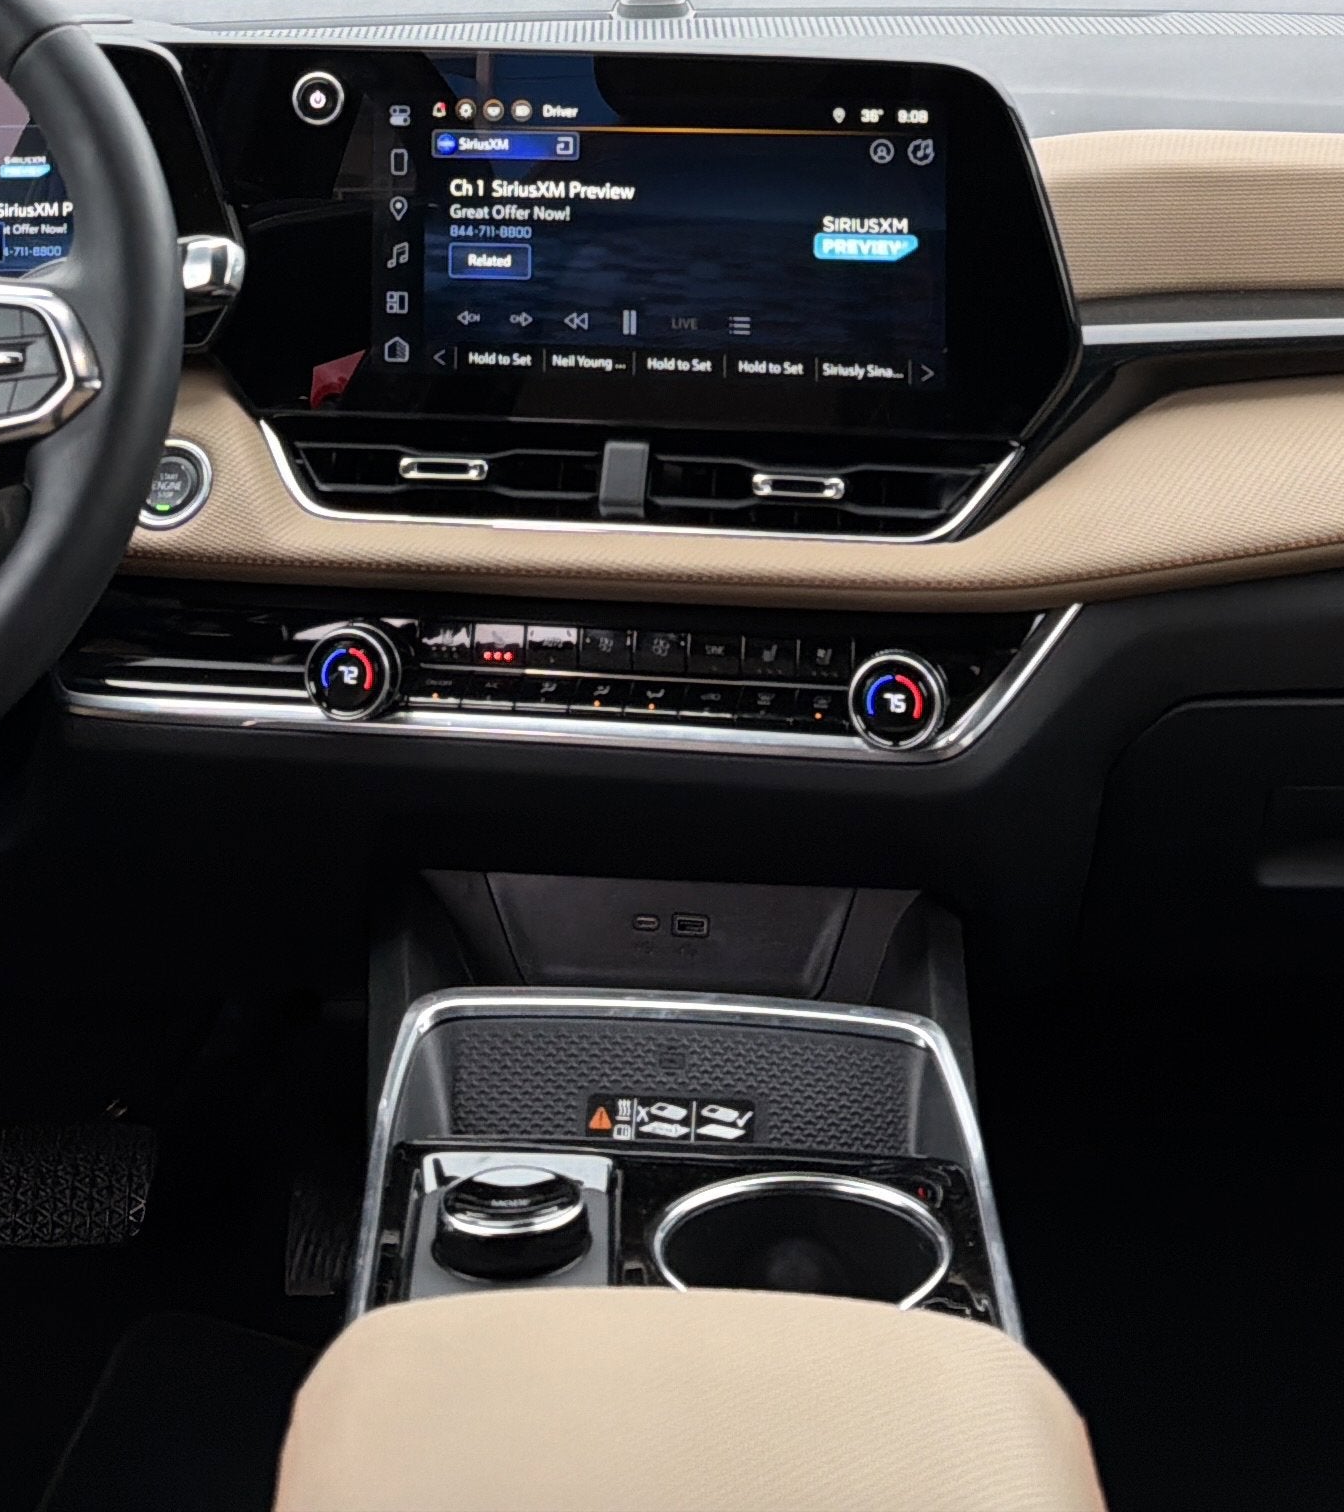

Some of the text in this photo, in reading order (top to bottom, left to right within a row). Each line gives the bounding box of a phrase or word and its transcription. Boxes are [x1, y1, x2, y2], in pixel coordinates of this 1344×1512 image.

[542, 103, 579, 119] Driver
[458, 137, 509, 152] SiriusXM
[450, 178, 635, 200] Ch 1 SiriusXM Preview
[450, 203, 571, 221] Great Offer Now!
[12, 224, 36, 235] Offer
[41, 223, 68, 235] Now!
[467, 253, 512, 268] Related
[671, 317, 699, 330] LIVE
[468, 351, 532, 366] Hold to Set
[552, 353, 576, 367] Neil
[577, 354, 613, 371] Young
[647, 357, 712, 372] Hold to Set
[738, 360, 804, 375] Hold to Set
[338, 664, 359, 686] 72
[882, 692, 906, 713] 75
